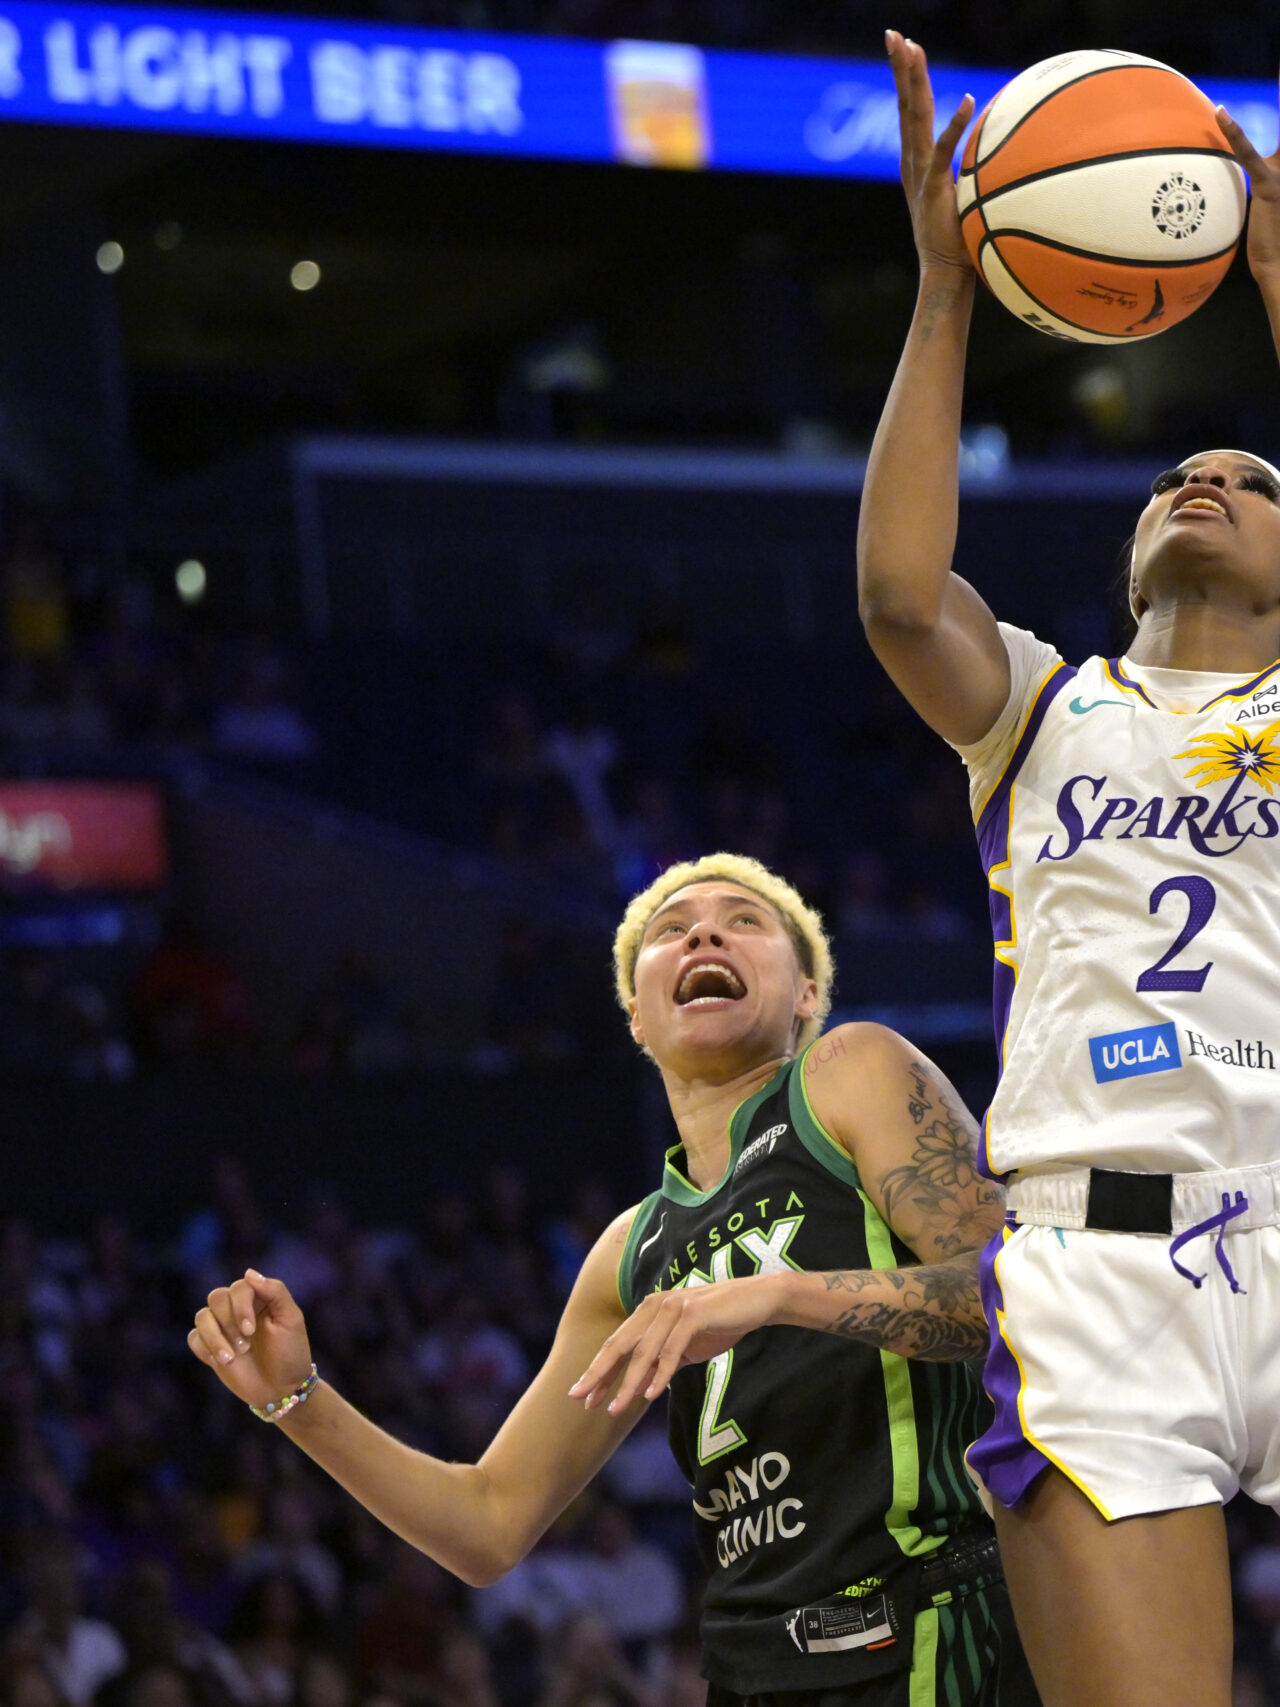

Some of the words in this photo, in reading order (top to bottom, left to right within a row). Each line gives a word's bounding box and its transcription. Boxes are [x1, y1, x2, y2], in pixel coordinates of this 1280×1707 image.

[44, 20, 291, 118] LIGHT
[311, 40, 524, 136] BEER
[1136, 875, 1217, 993] 2
[1102, 1035, 1170, 1070] UCLA
[1185, 1030, 1276, 1070] Health
[654, 1190, 804, 1293] NNESOTA
[690, 1451, 791, 1521] MAYO
[717, 1497, 806, 1568] CLINIC
[808, 1620, 819, 1629] 38
